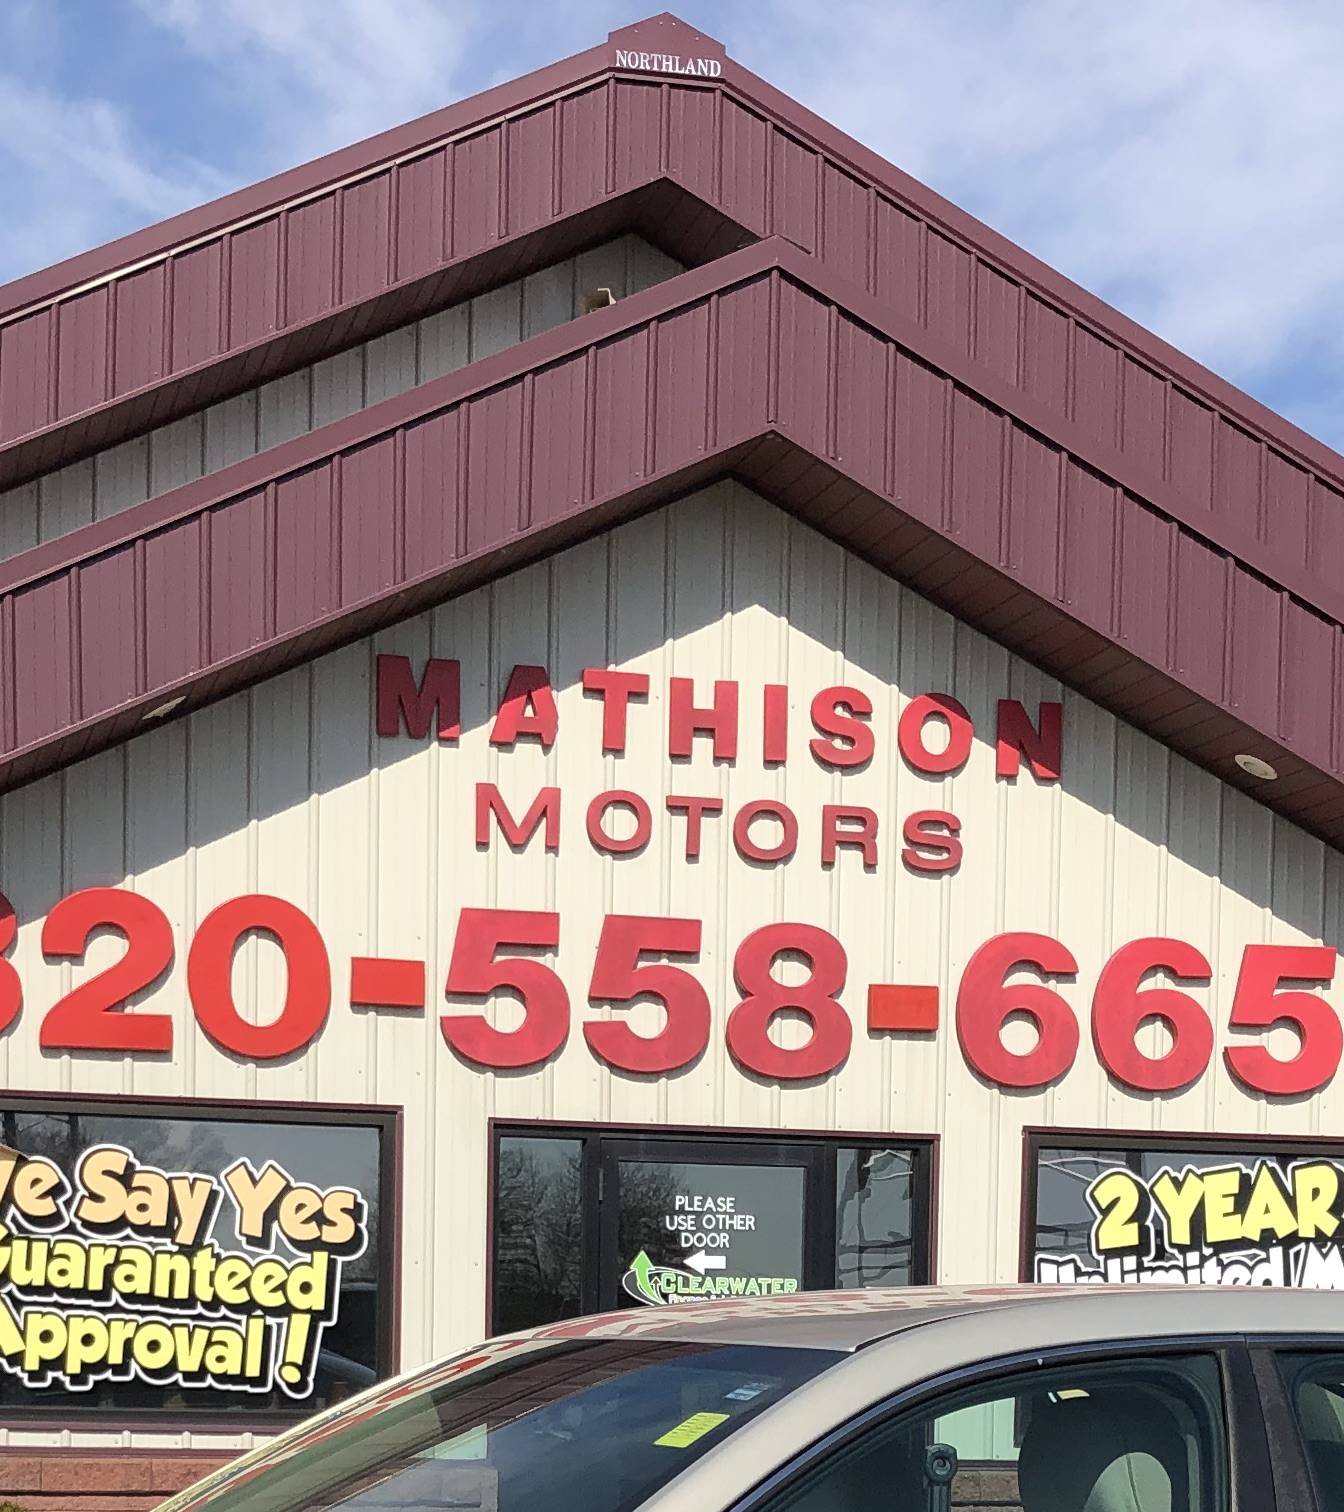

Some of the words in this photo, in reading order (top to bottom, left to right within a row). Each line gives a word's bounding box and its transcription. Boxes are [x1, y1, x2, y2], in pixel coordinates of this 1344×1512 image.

[615, 49, 722, 77] NORTHLAND
[375, 653, 1063, 782] MATHISON
[474, 781, 963, 873] MOTORS
[77, 1147, 215, 1246] Say
[224, 1163, 356, 1244] Yes
[674, 1194, 736, 1213] PLEASE
[1090, 1173, 1140, 1250] 2
[1152, 1163, 1342, 1246] YEAR
[664, 1214, 697, 1231] USE
[701, 1213, 756, 1231] OTHER
[680, 1232, 730, 1249] DOOR
[660, 1272, 798, 1296] CLEARWATER
